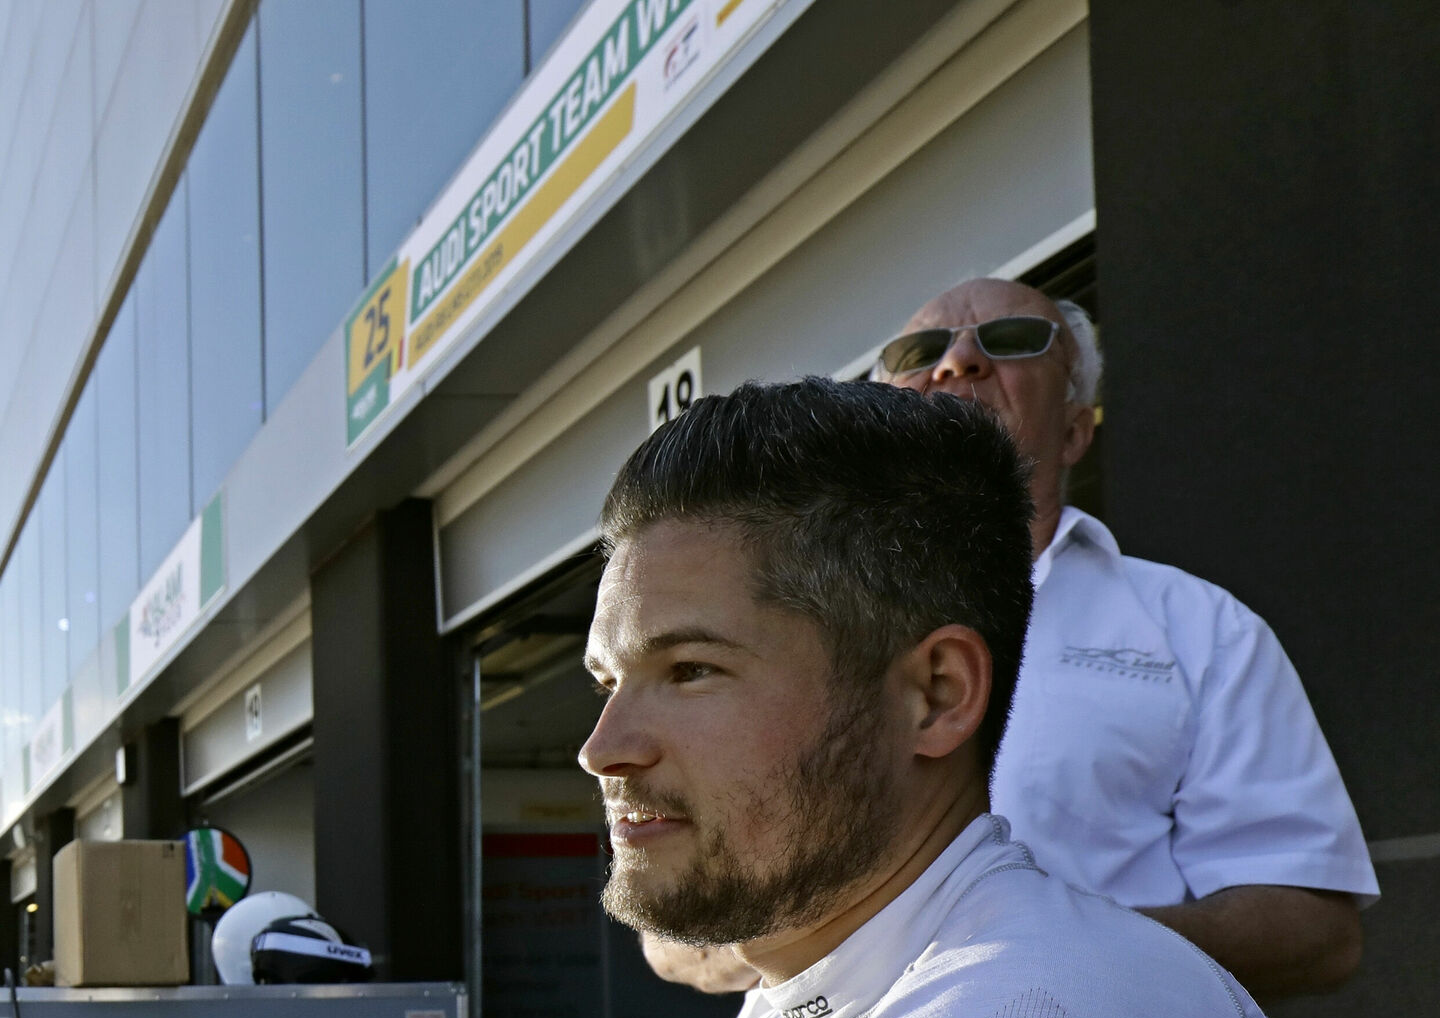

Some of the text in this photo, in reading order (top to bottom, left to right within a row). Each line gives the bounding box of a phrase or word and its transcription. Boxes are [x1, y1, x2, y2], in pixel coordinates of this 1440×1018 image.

[417, 217, 466, 309] AUDI
[468, 119, 546, 249] SPORT
[547, 17, 630, 154] TEAM
[364, 288, 391, 370] 25
